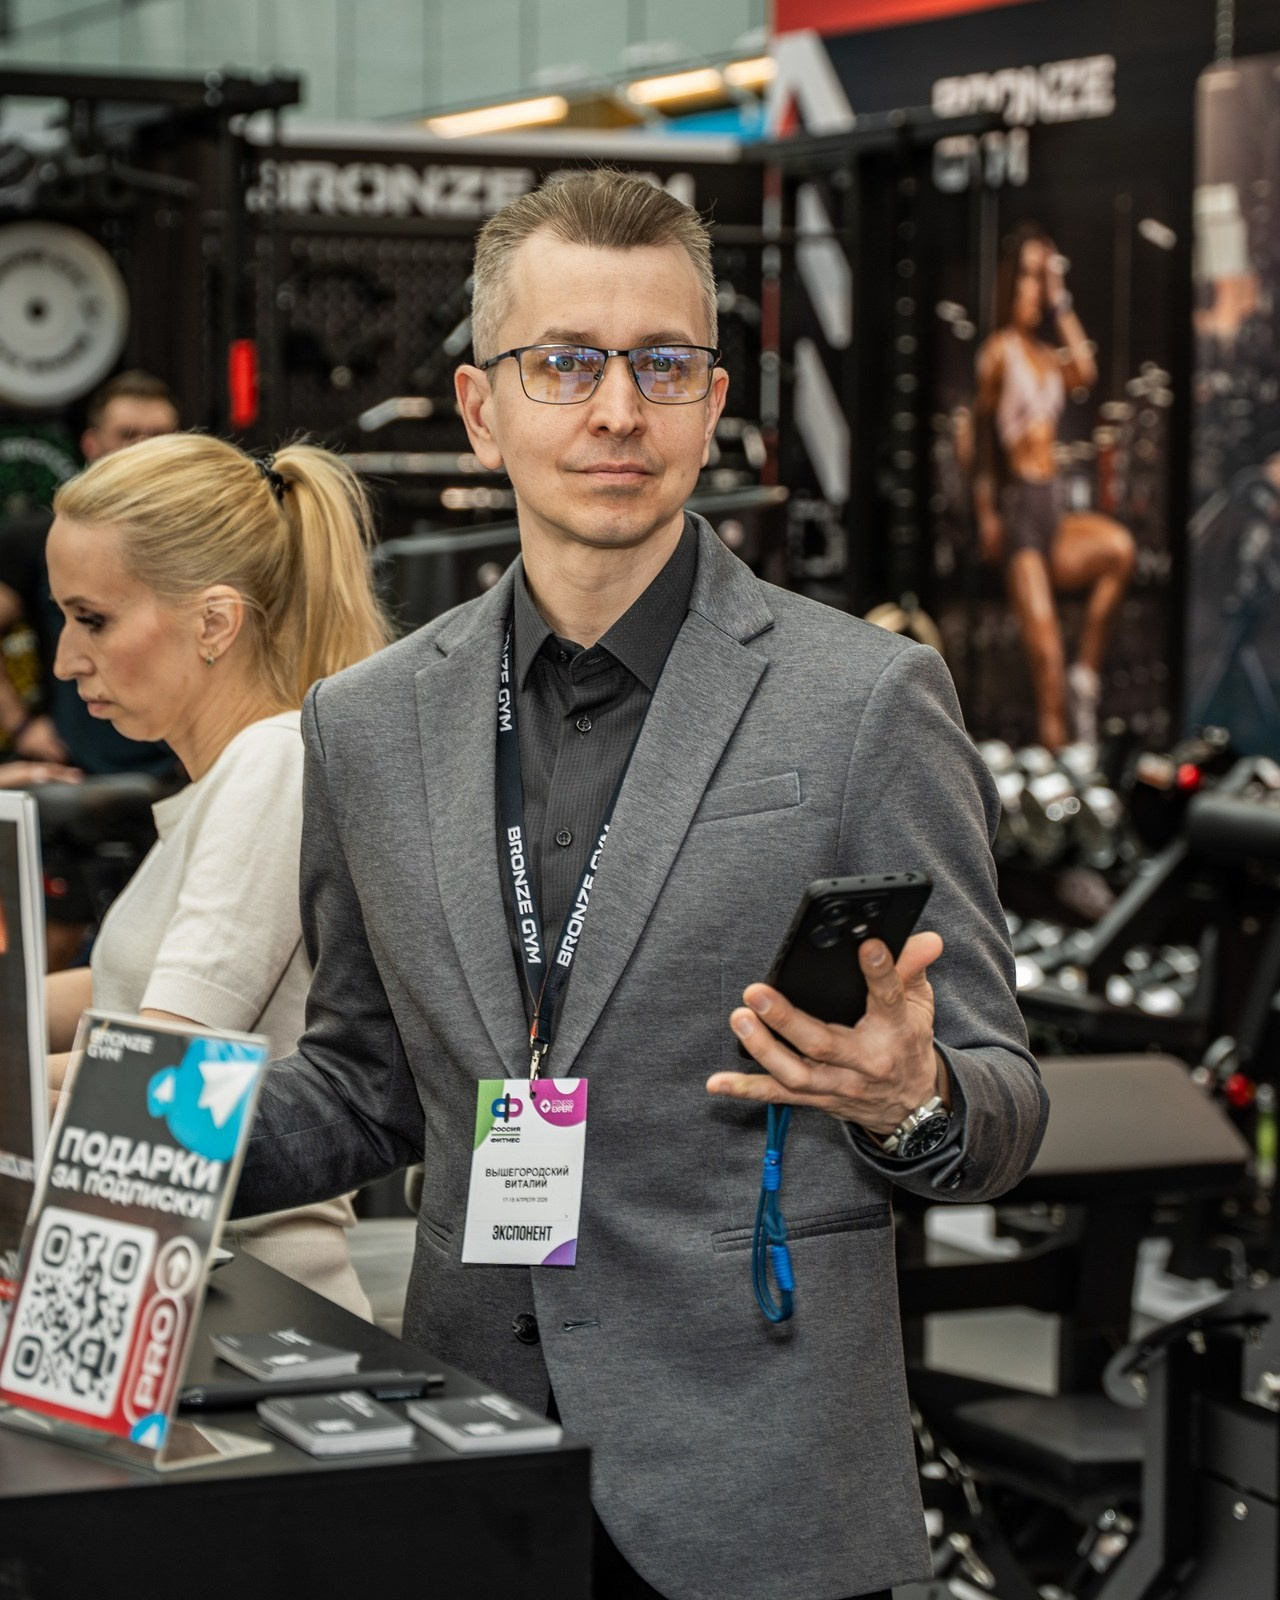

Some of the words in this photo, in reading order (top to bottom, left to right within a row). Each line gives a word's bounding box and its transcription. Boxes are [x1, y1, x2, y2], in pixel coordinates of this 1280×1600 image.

[499, 687, 513, 733] GYM
[507, 825, 534, 916] BRONZE
[521, 918, 542, 964] GYM
[556, 873, 595, 968] BRONZE
[86, 1043, 124, 1063] GYM
[89, 1027, 155, 1055] BRONZE
[58, 1126, 224, 1194] ПОДАРКИ
[485, 1165, 570, 1179] ВЫШЕГОРОДСКИЙ
[50, 1163, 82, 1191] ЗА
[83, 1171, 215, 1221] ПОДПИСКУ!
[504, 1178, 548, 1189] ВИТАЛИЙ
[492, 1225, 553, 1241] ЭКСПОНЕНТ
[134, 1304, 176, 1410] PRO
